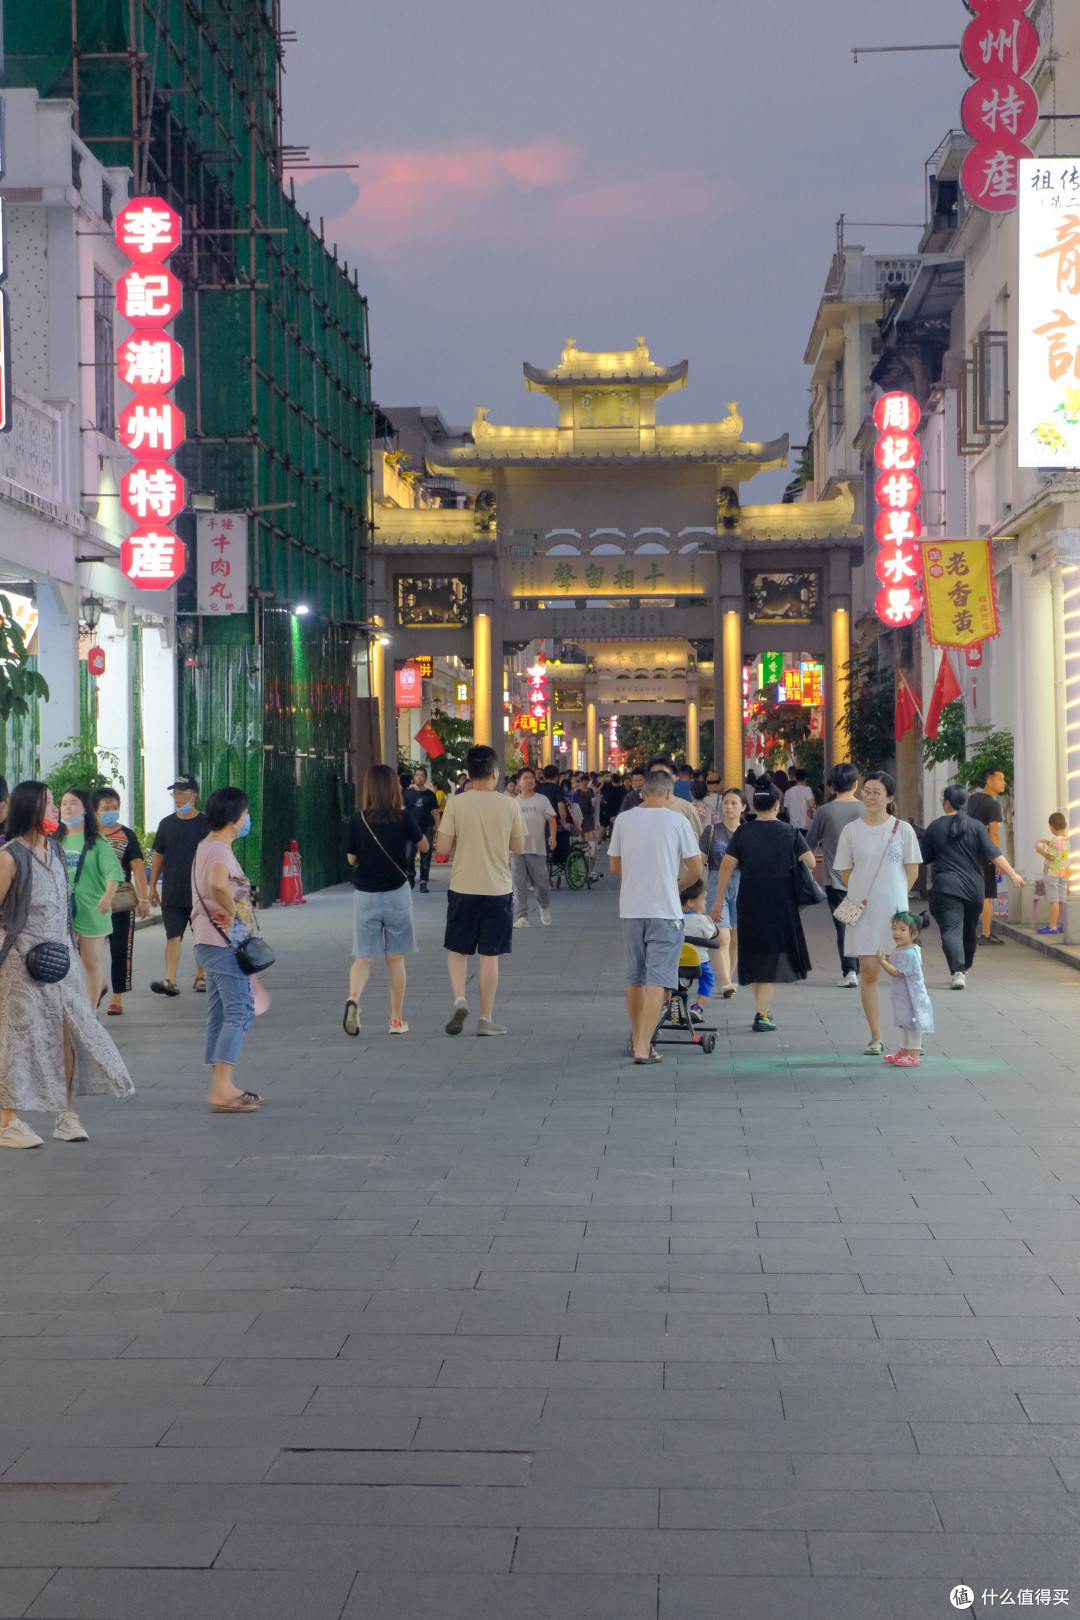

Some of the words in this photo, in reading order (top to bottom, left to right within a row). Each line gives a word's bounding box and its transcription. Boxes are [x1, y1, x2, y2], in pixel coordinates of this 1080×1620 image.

[123, 208, 177, 579] 李記潮州特産
[209, 533, 233, 599] 牛肉丸
[882, 396, 917, 622] 周記甘草水果
[945, 551, 974, 636] 老香黄
